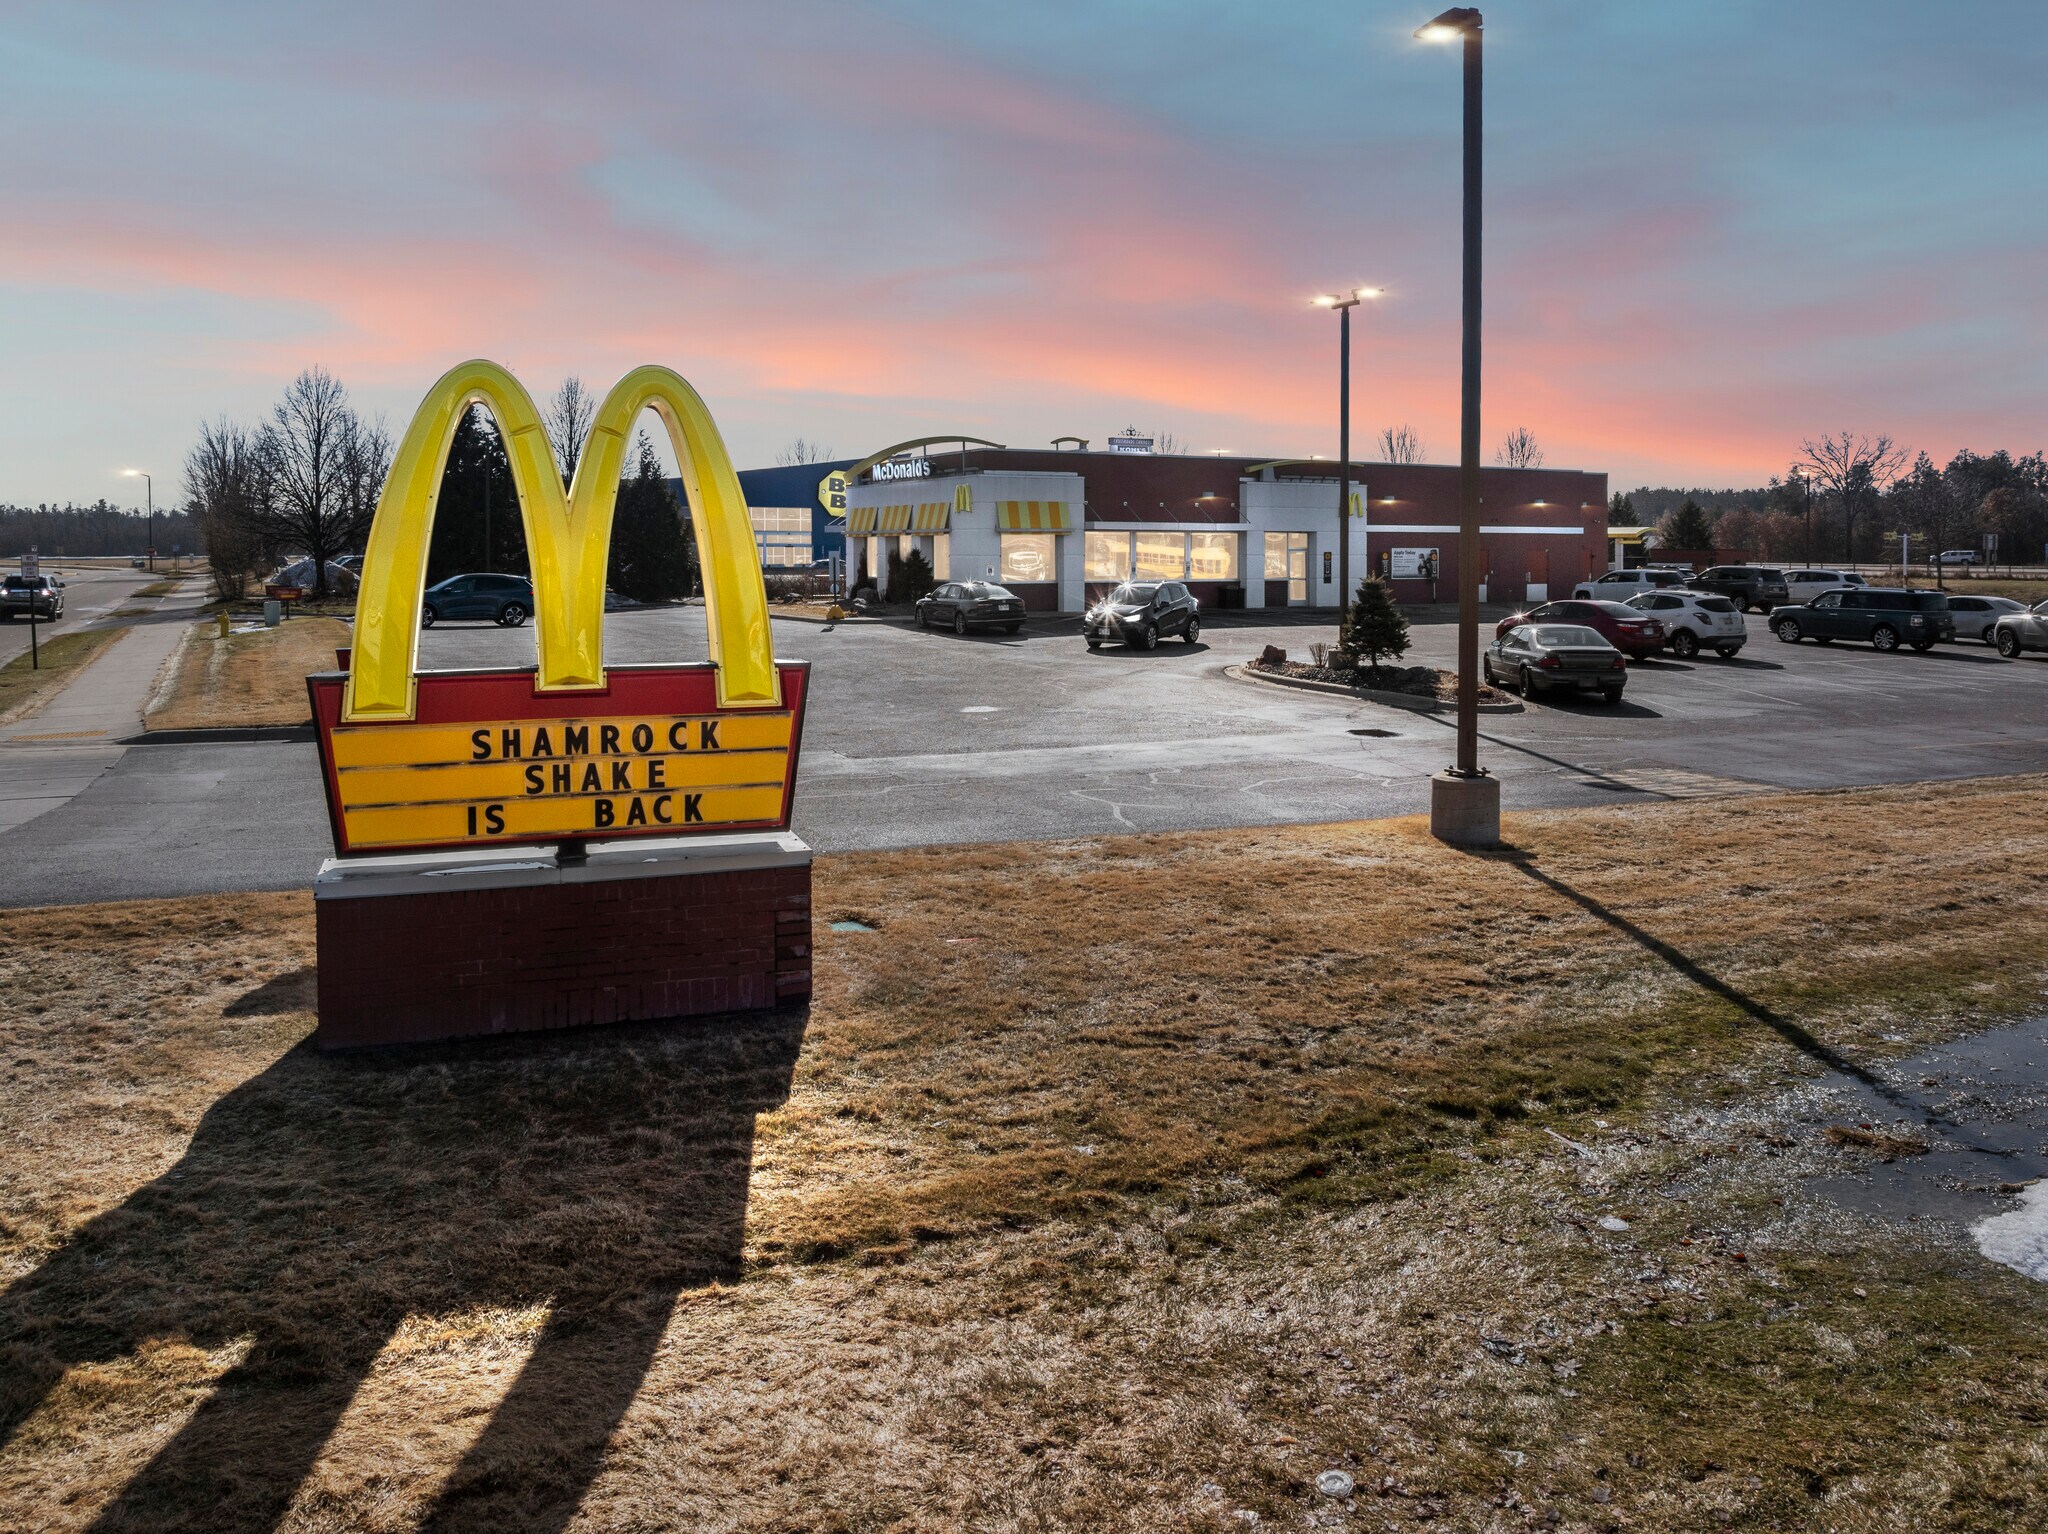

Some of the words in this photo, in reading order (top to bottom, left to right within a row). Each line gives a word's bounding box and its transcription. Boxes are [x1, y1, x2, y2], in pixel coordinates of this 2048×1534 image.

[872, 458, 930, 481] McDonald's
[472, 721, 720, 760] SHAMROCK
[525, 760, 665, 795] SHAKE
[467, 804, 505, 836] IS
[594, 793, 704, 828] BACK
